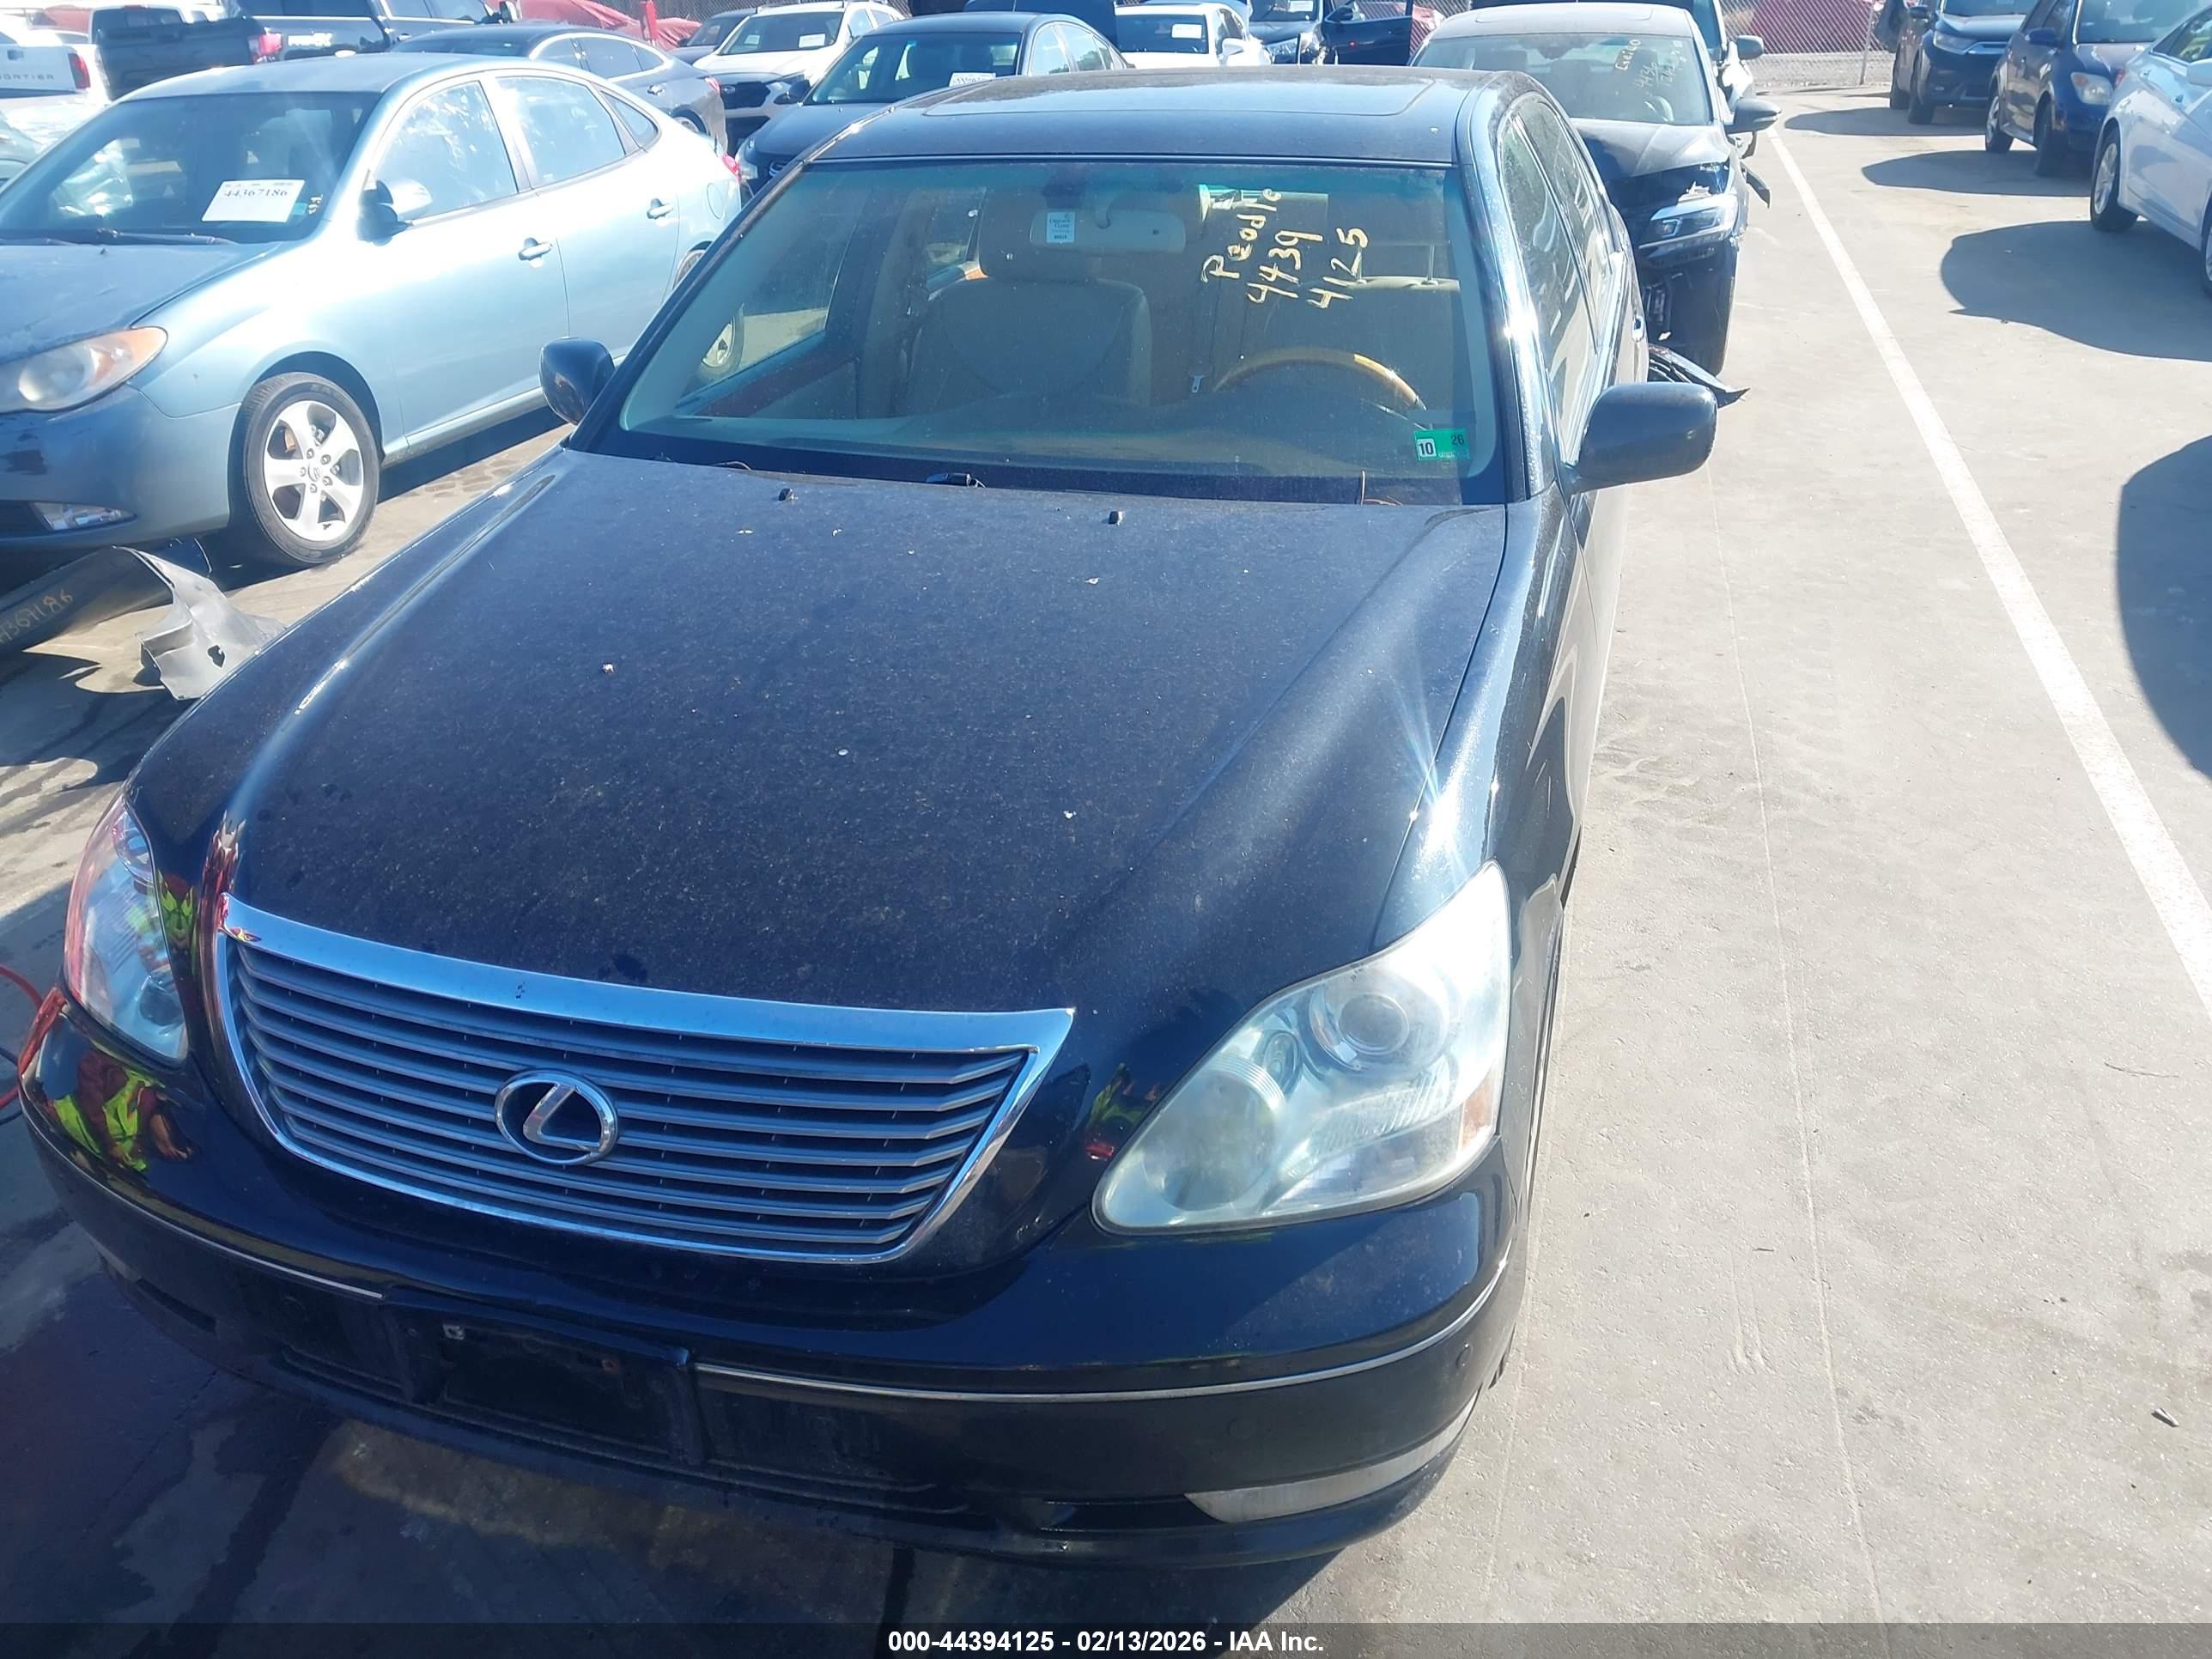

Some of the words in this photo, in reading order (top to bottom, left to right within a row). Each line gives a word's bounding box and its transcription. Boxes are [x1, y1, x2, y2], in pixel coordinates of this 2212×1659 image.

[1246, 229, 1324, 303] 4439
[1307, 228, 1369, 309] 4125
[1419, 441, 1434, 456] 10
[1449, 434, 1465, 447] 26
